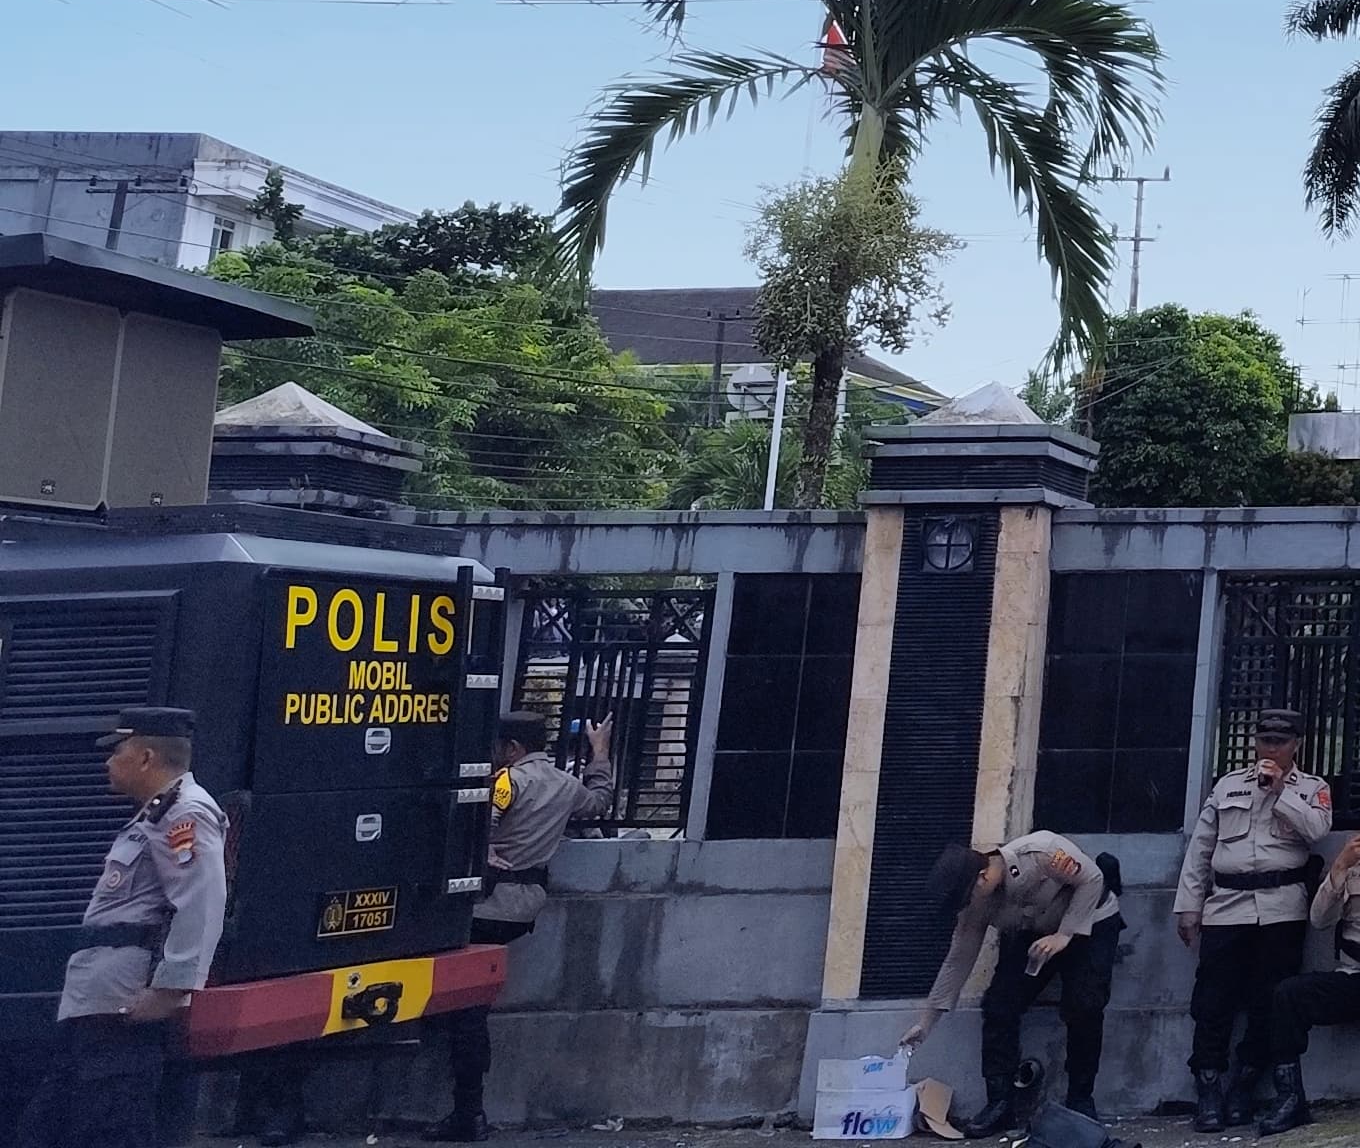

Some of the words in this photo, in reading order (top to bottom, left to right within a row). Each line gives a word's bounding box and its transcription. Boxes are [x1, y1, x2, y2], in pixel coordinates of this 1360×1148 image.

[348, 660, 413, 691] MOBIL
[284, 693, 366, 725] PUBLIC
[367, 693, 450, 724] ADDRES
[354, 891, 391, 908] XXXIV
[352, 910, 388, 929] 17051
[841, 1111, 902, 1136] flow
